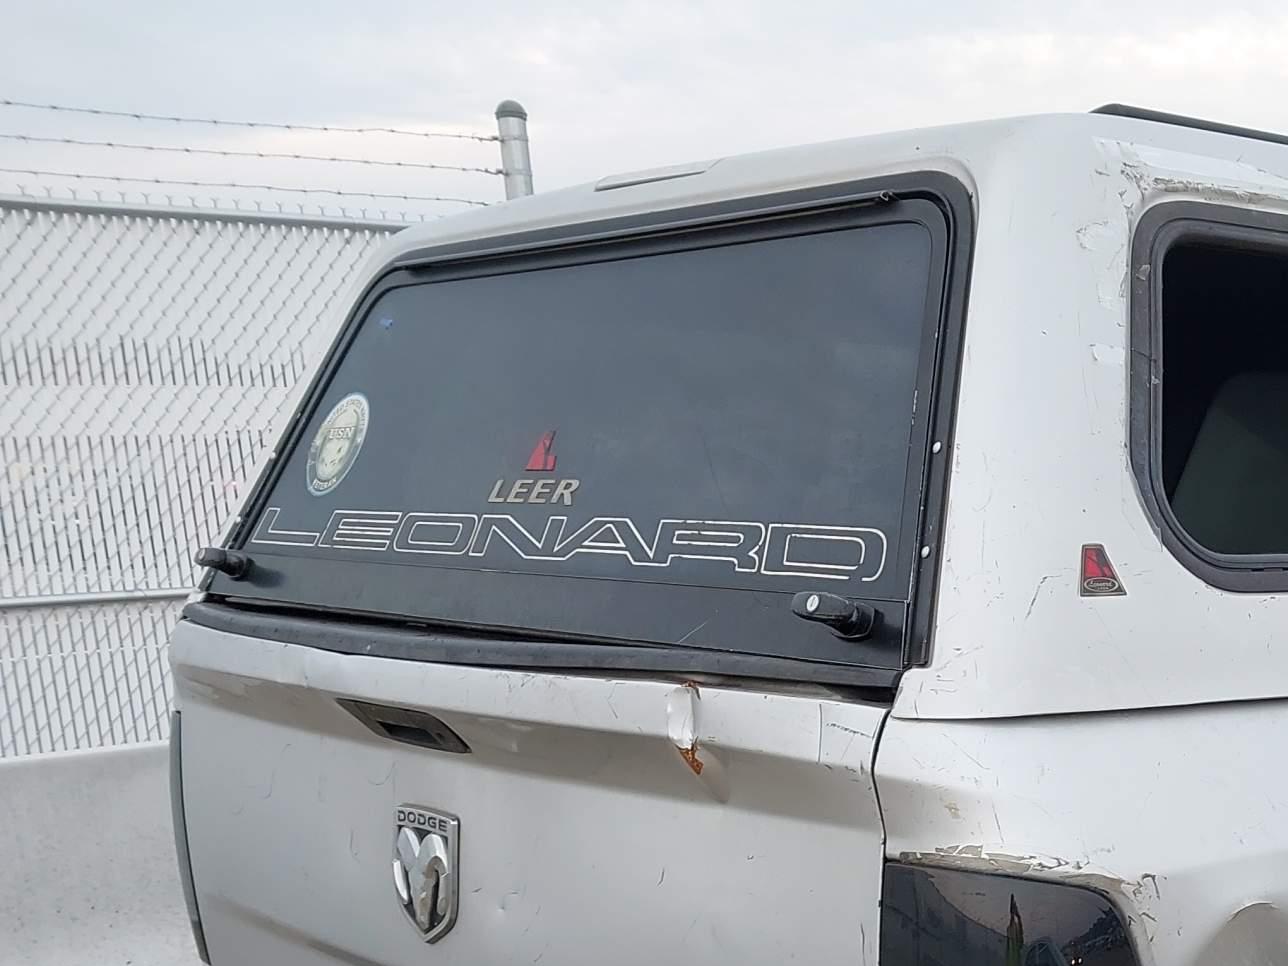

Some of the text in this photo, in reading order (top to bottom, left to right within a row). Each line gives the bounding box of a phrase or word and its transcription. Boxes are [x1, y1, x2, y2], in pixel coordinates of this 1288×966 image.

[328, 427, 354, 441] USN
[488, 476, 580, 506] LEER
[250, 507, 888, 583] LEONARD
[397, 810, 447, 832] DODGE
